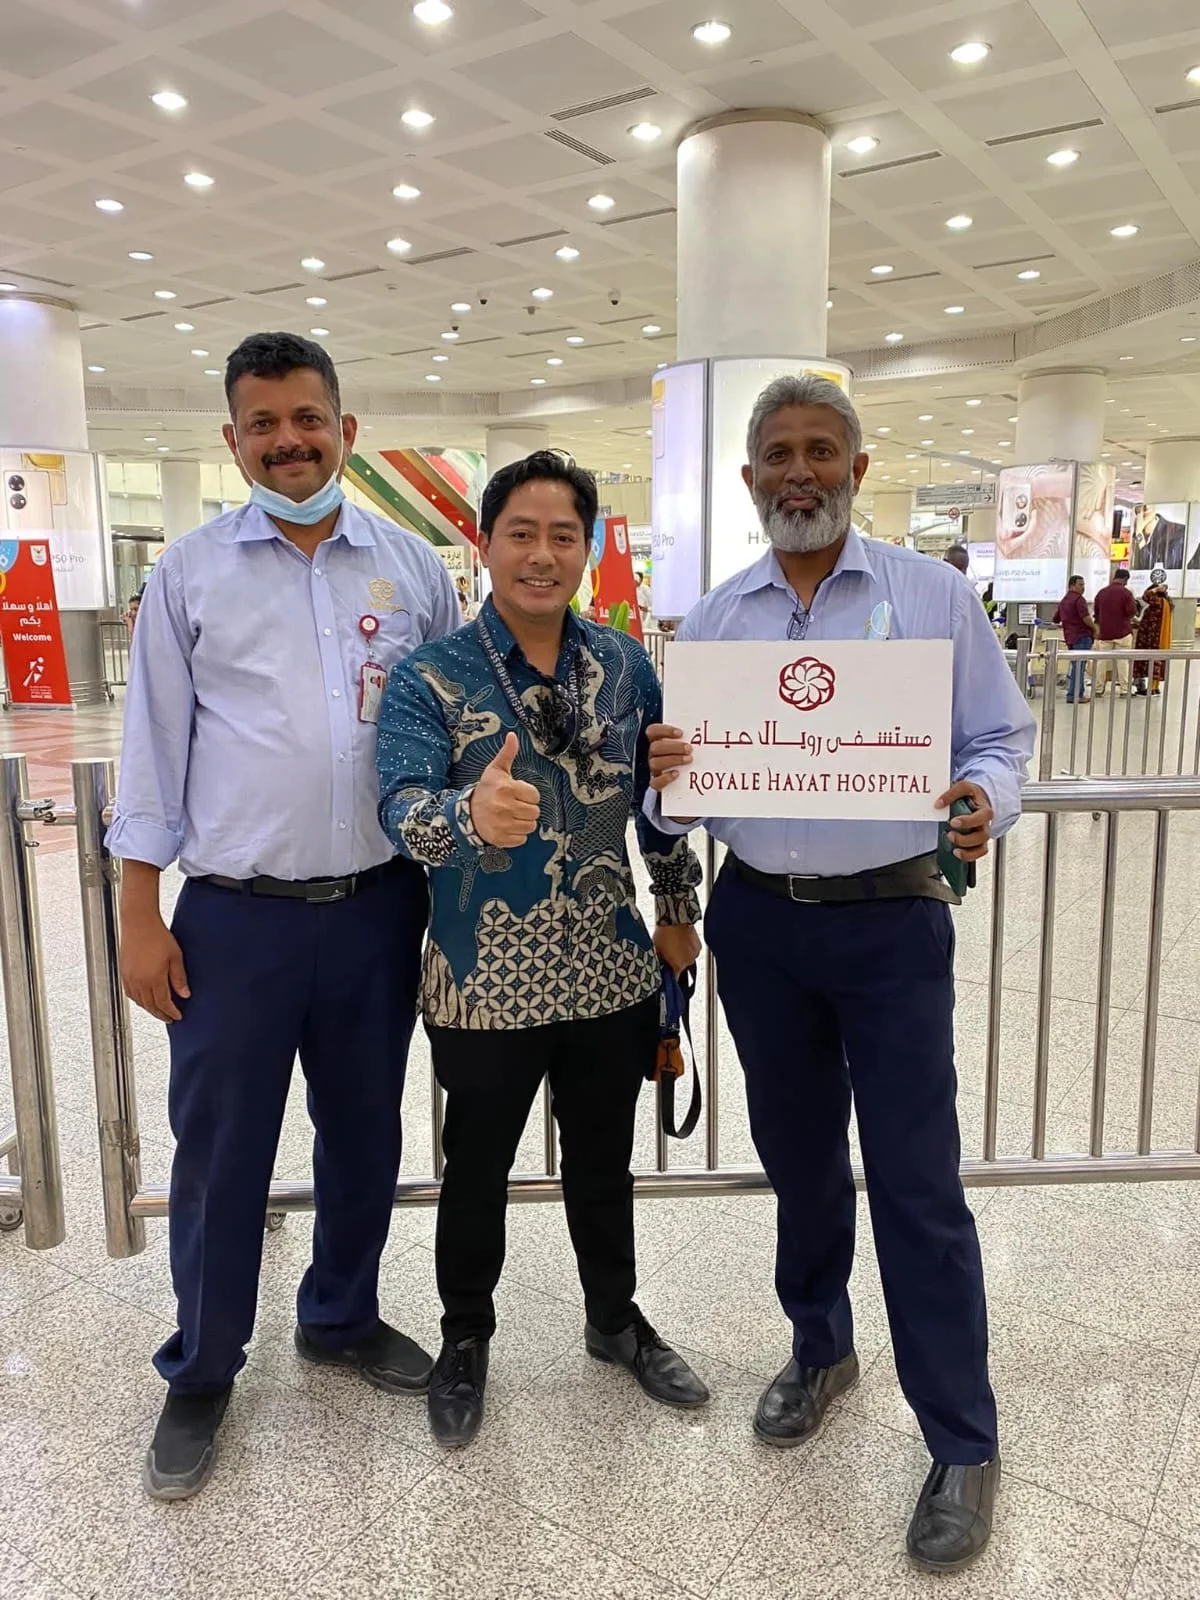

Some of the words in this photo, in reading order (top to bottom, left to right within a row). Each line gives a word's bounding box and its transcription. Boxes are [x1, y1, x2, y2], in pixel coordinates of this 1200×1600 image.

[661, 533, 675, 547] Pro
[19, 616, 41, 627] بكم
[12, 632, 53, 642] Welcome
[690, 720, 754, 749] حياة
[758, 720, 822, 756] رويال
[826, 726, 931, 753] مستشفى
[688, 771, 760, 796] ROYALE
[767, 767, 831, 792] HAYAT
[836, 773, 931, 793] HOSPITAL
